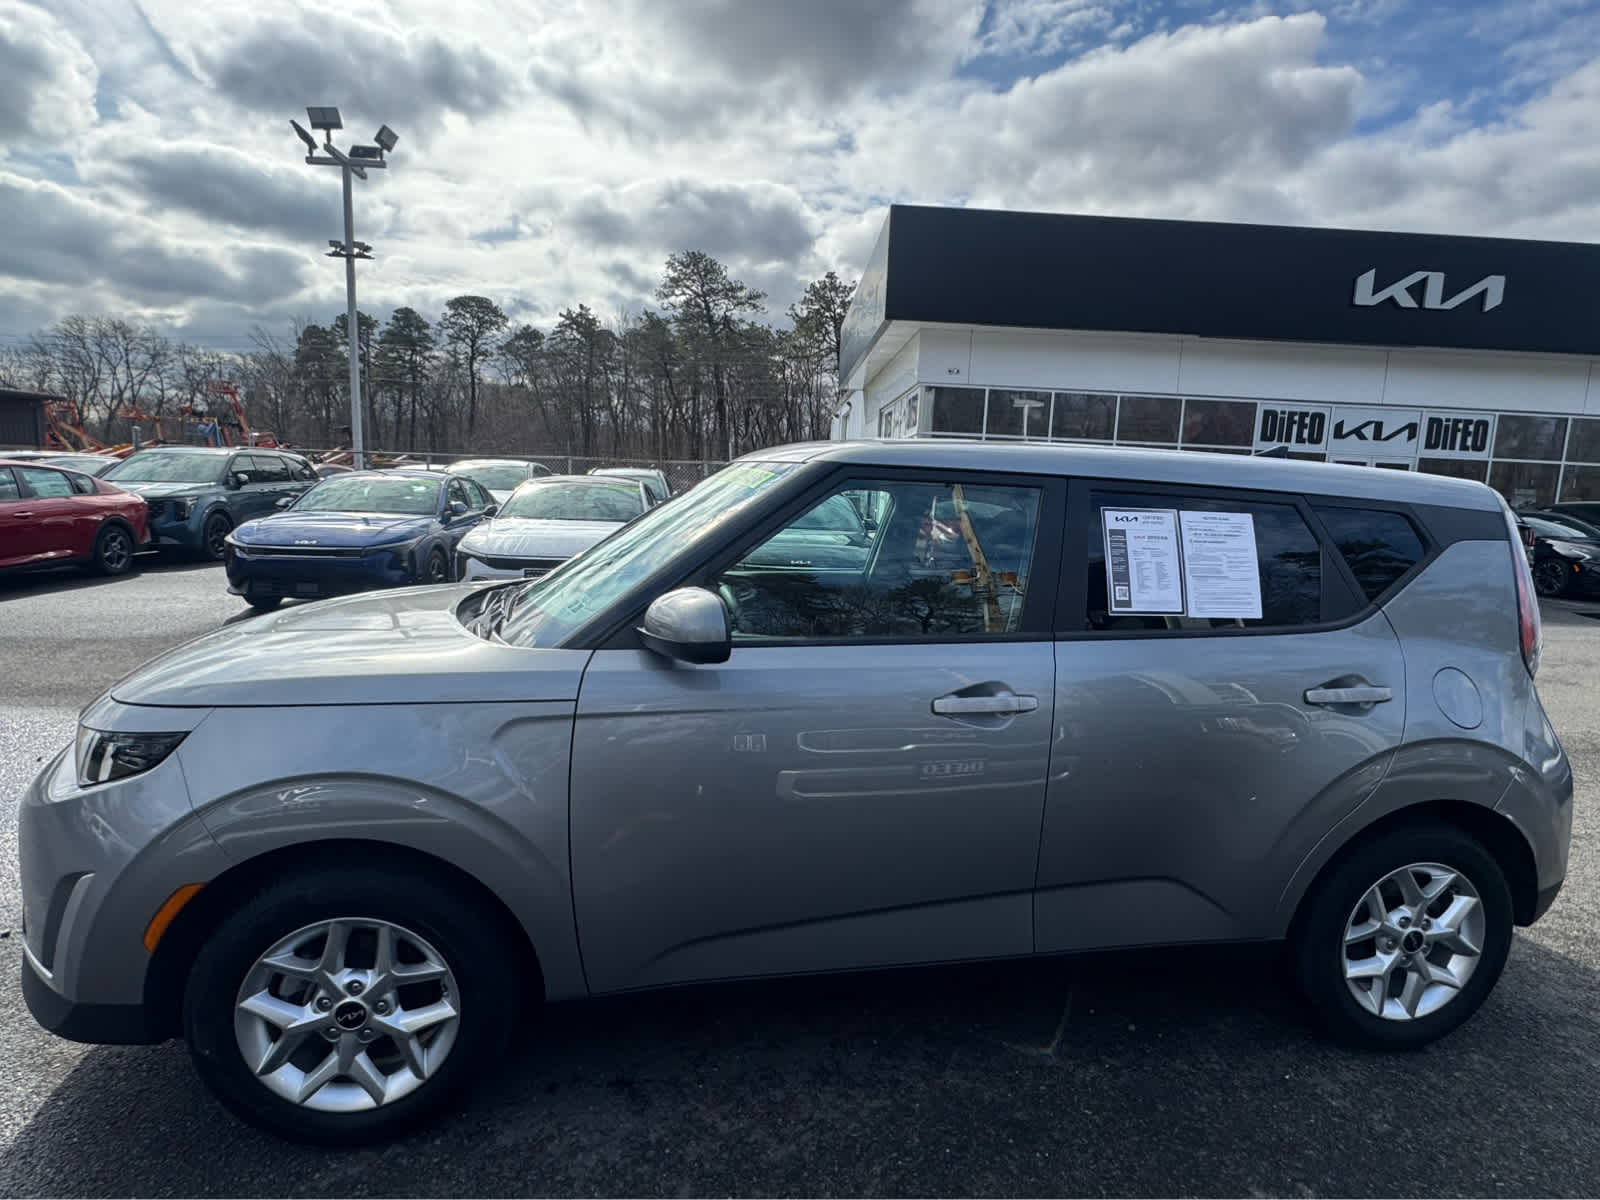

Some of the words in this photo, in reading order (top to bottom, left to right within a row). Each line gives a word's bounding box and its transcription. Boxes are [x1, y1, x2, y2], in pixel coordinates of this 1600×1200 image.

[1353, 267, 1506, 313] KIA
[1260, 408, 1326, 445] DiFEO
[1333, 419, 1418, 443] KIA
[1424, 416, 1490, 452] DiFEO
